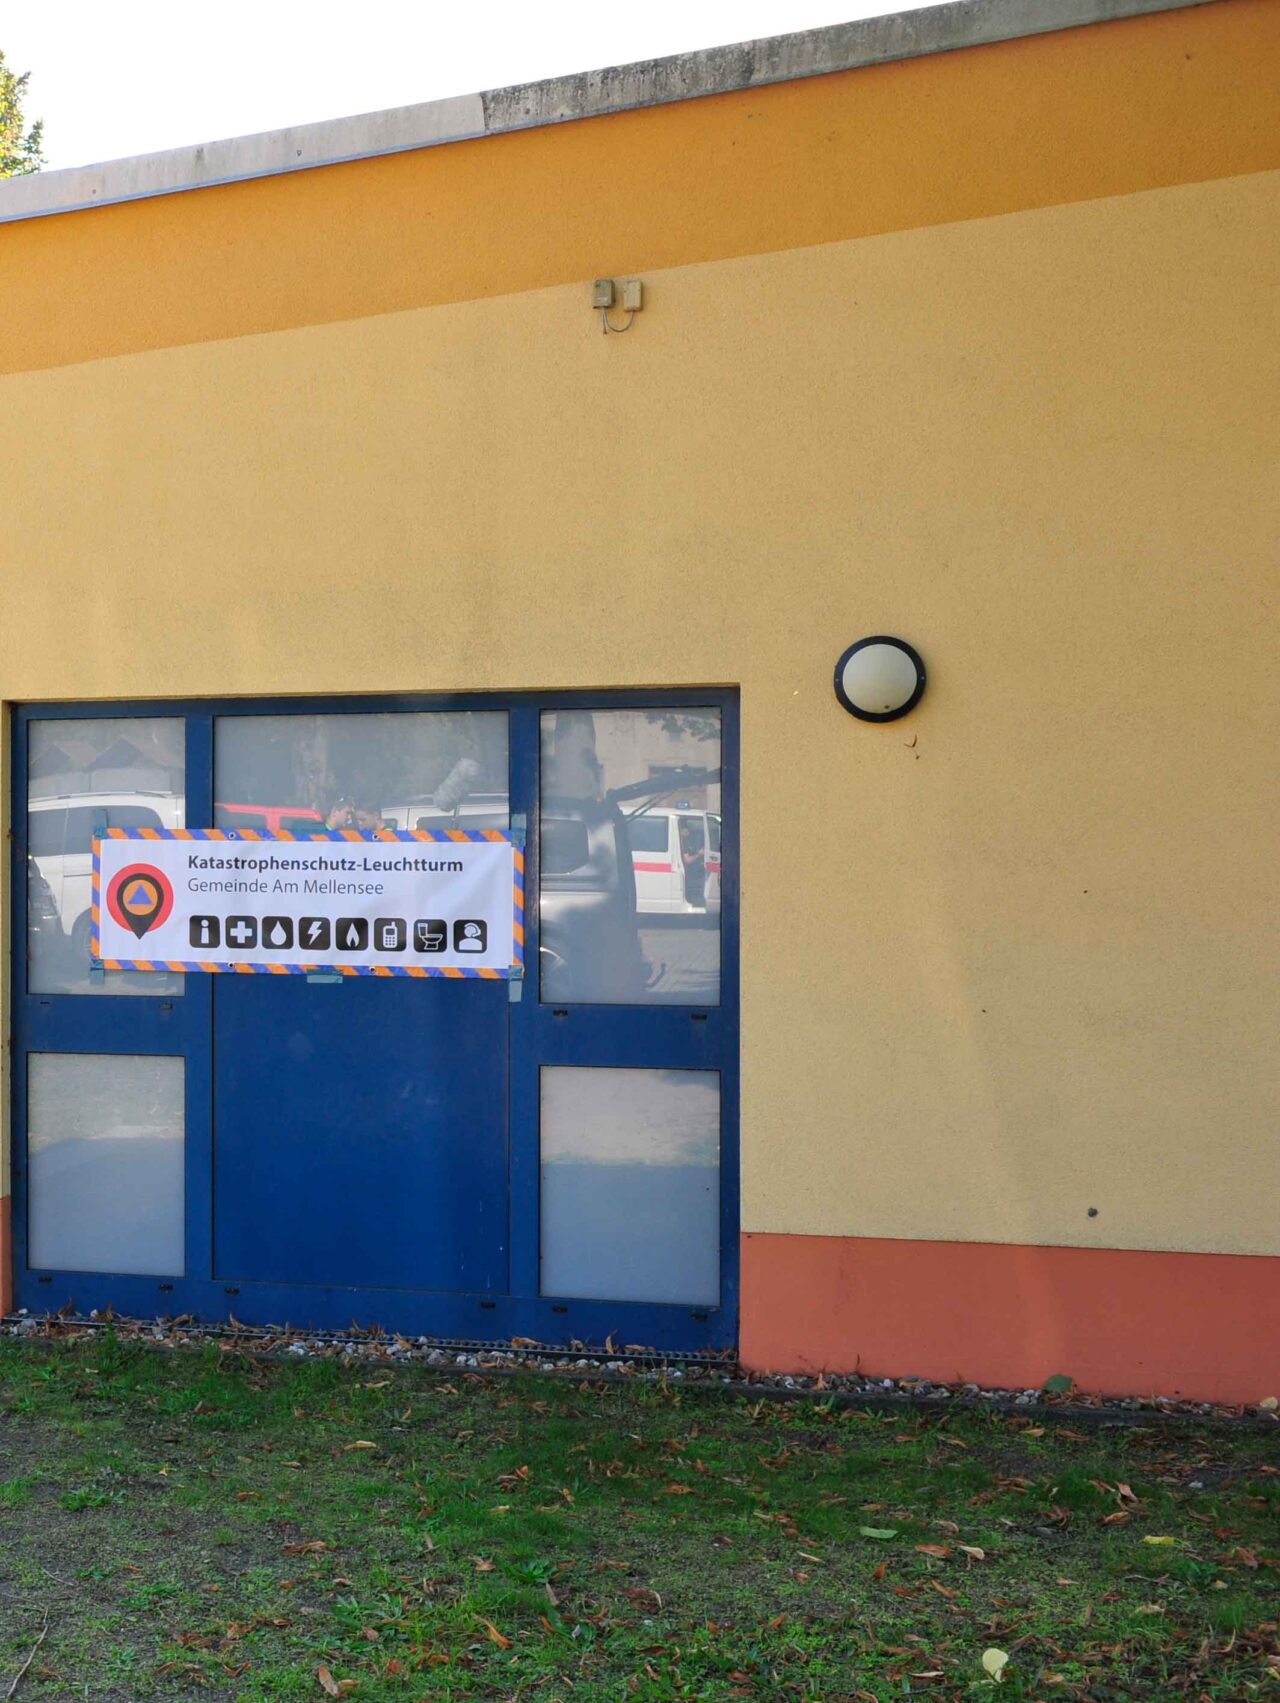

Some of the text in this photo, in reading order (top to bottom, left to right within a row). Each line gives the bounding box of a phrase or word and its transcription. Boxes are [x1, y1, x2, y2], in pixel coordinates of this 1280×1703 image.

[188, 855, 463, 873] Katastrophenschutz-Leuchtturm
[188, 878, 384, 895] Gemeinde Am Mellensee
